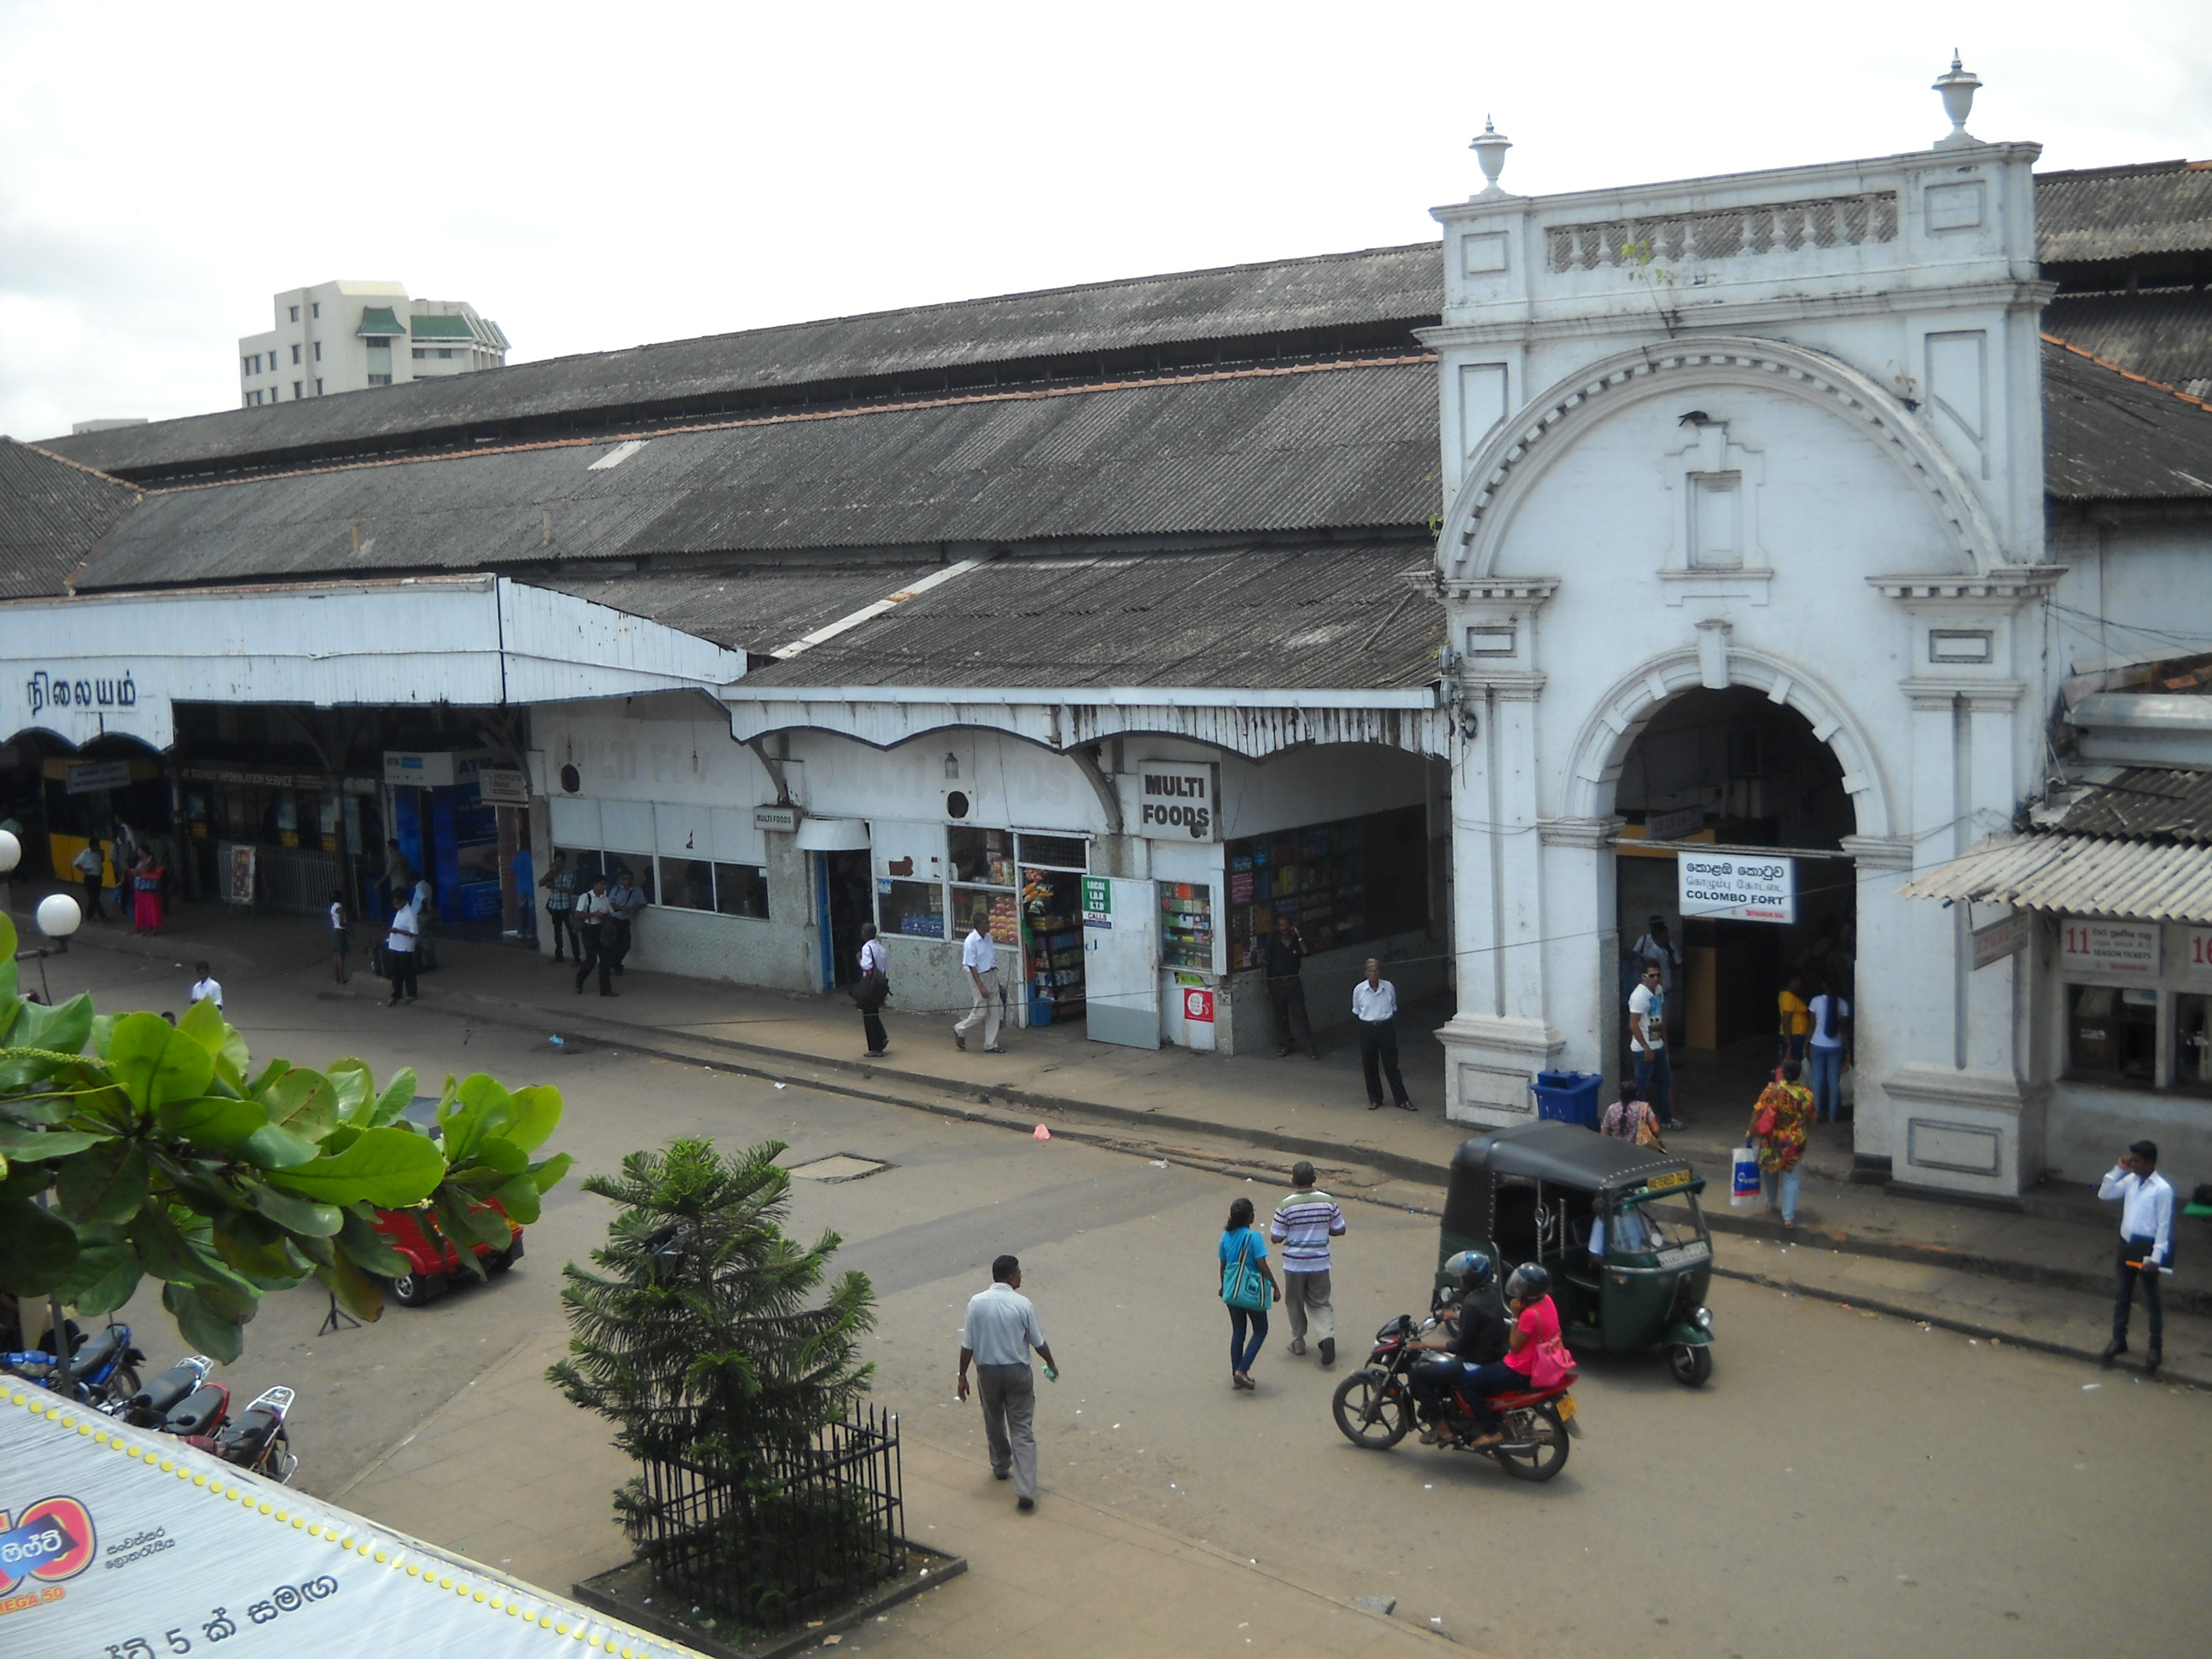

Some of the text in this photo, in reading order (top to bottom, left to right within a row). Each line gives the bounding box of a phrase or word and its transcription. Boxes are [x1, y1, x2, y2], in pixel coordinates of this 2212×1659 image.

[26, 669, 137, 716] நிலையம்
[218, 771, 265, 784] INFORMATION
[265, 774, 293, 787] SERVICE
[1144, 774, 1205, 798] MULTI
[1143, 804, 1209, 828] FOODS
[1686, 862, 1784, 881] කොළඹ කොටුව
[1086, 880, 1106, 890] LOCAL
[1686, 890, 1784, 905] COLOMBO FORT
[1087, 912, 1107, 921] CALLS
[2066, 927, 2090, 954] 11
[2093, 949, 2151, 959] SEASON TICKETS
[107, 1525, 166, 1555] සංවත්සර
[43, 1586, 66, 1604] 50
[166, 1627, 191, 1655] 5
[202, 1606, 237, 1643] ක්
